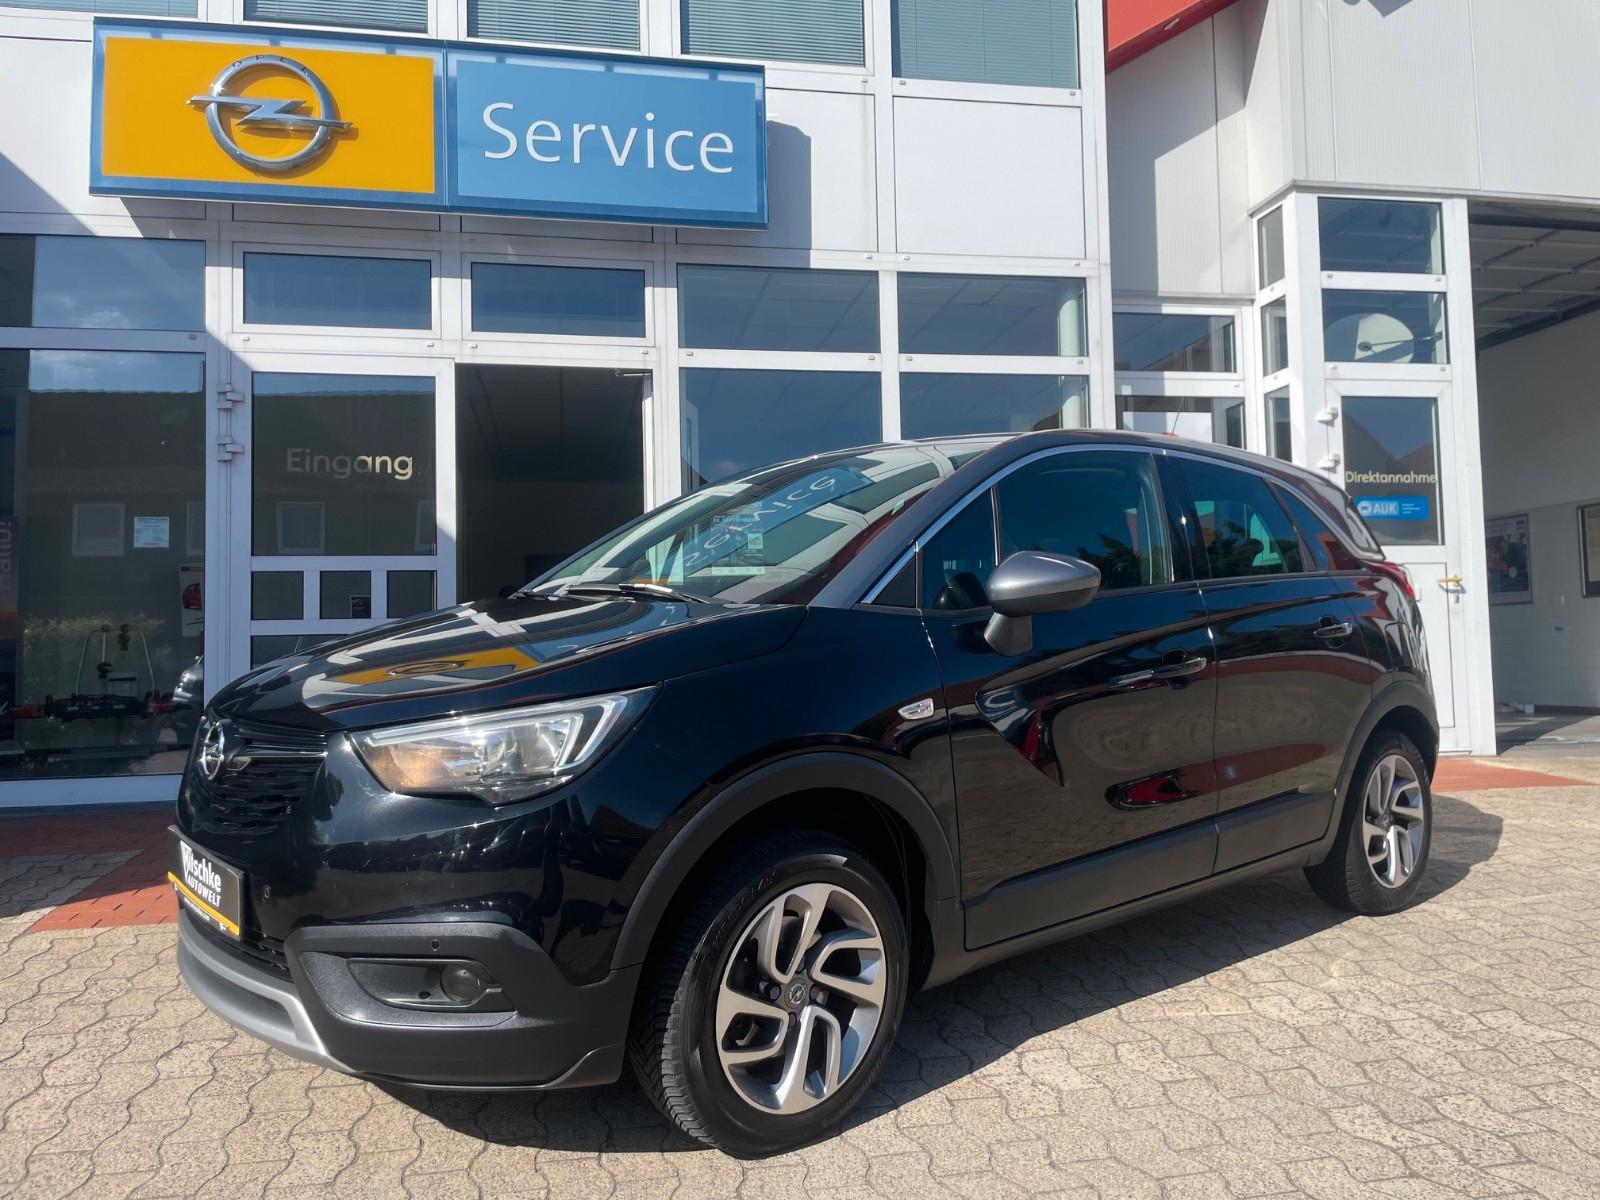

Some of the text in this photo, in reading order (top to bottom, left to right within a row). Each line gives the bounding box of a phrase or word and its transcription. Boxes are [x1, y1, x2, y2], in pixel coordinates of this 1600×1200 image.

[482, 102, 734, 174] Service
[286, 448, 413, 480] Eingang
[1345, 470, 1437, 484] Direktannahme
[1373, 502, 1397, 516] AUK
[187, 874, 221, 907] AUTOWELT
